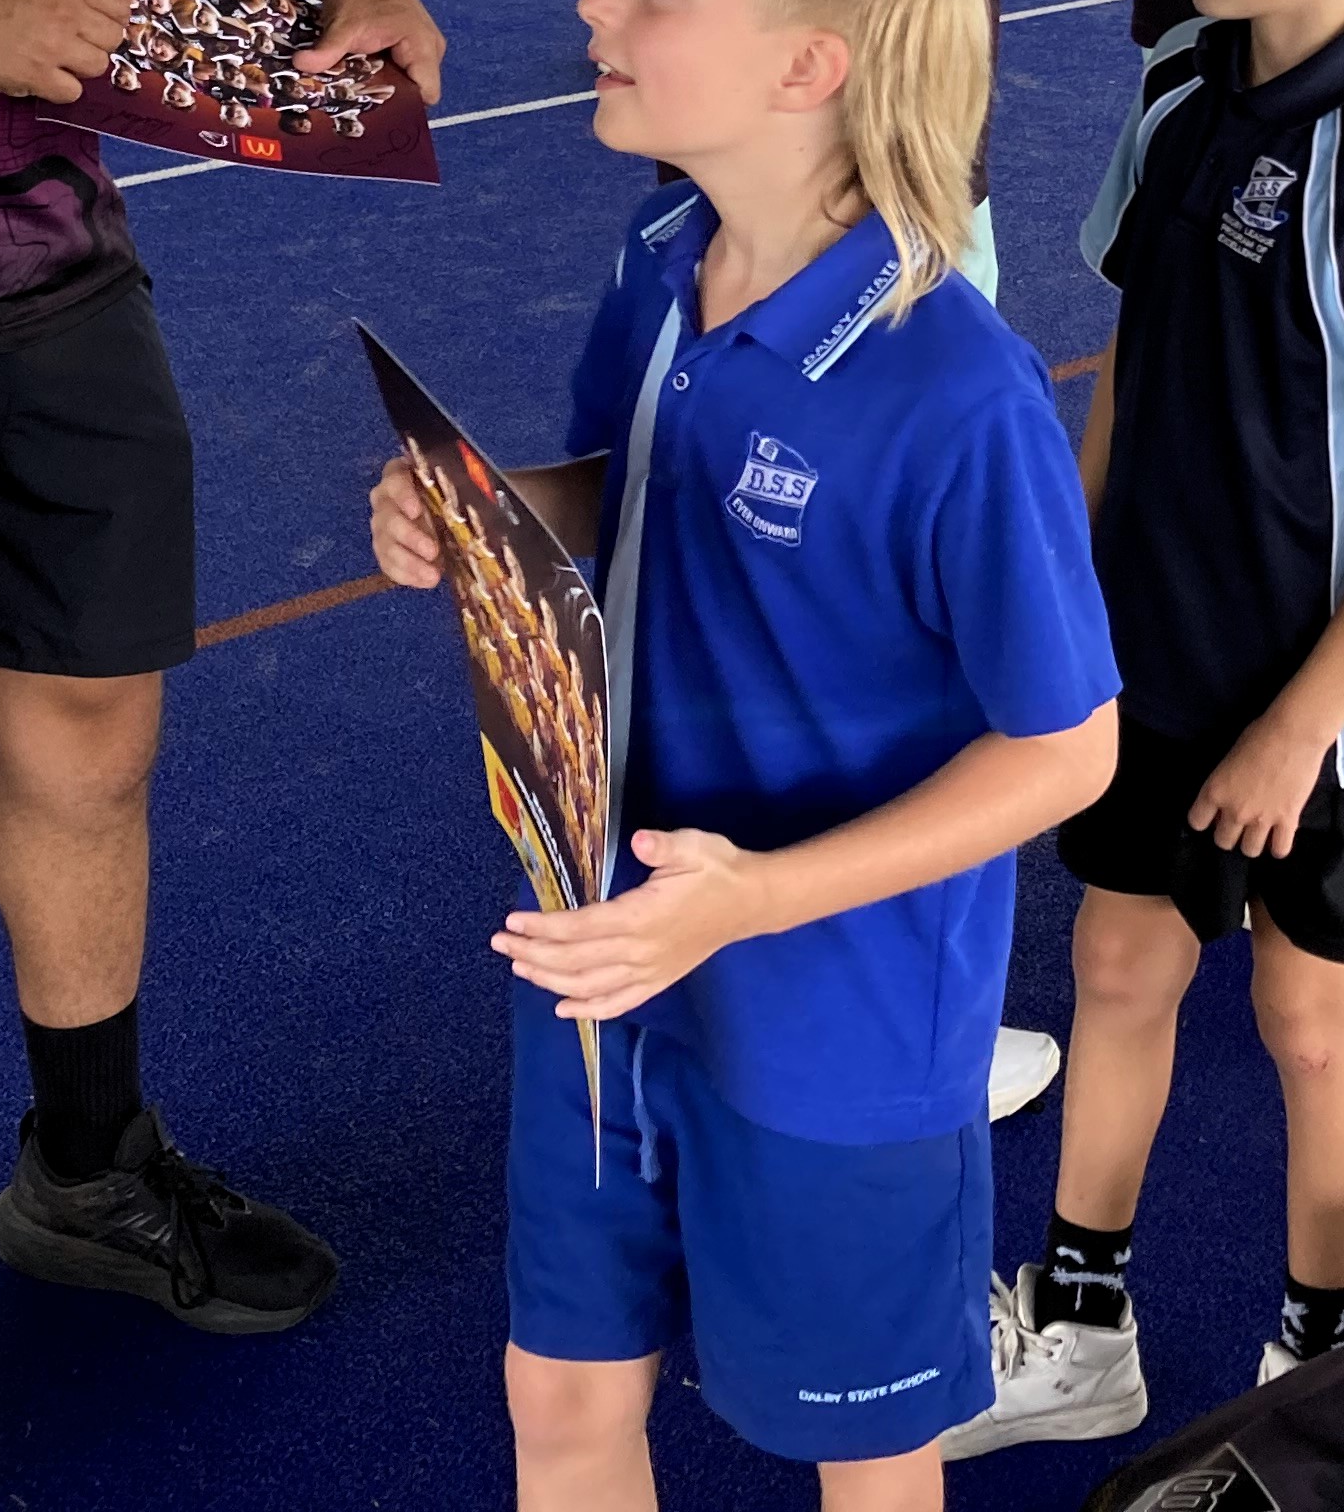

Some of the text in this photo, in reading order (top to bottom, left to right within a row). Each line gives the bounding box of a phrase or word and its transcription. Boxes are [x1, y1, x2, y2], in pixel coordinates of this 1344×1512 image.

[802, 259, 900, 366] DALBY STATE
[731, 496, 798, 539] EVER ONWARD
[798, 1367, 941, 1404] DALBY STATE SCHOOL
